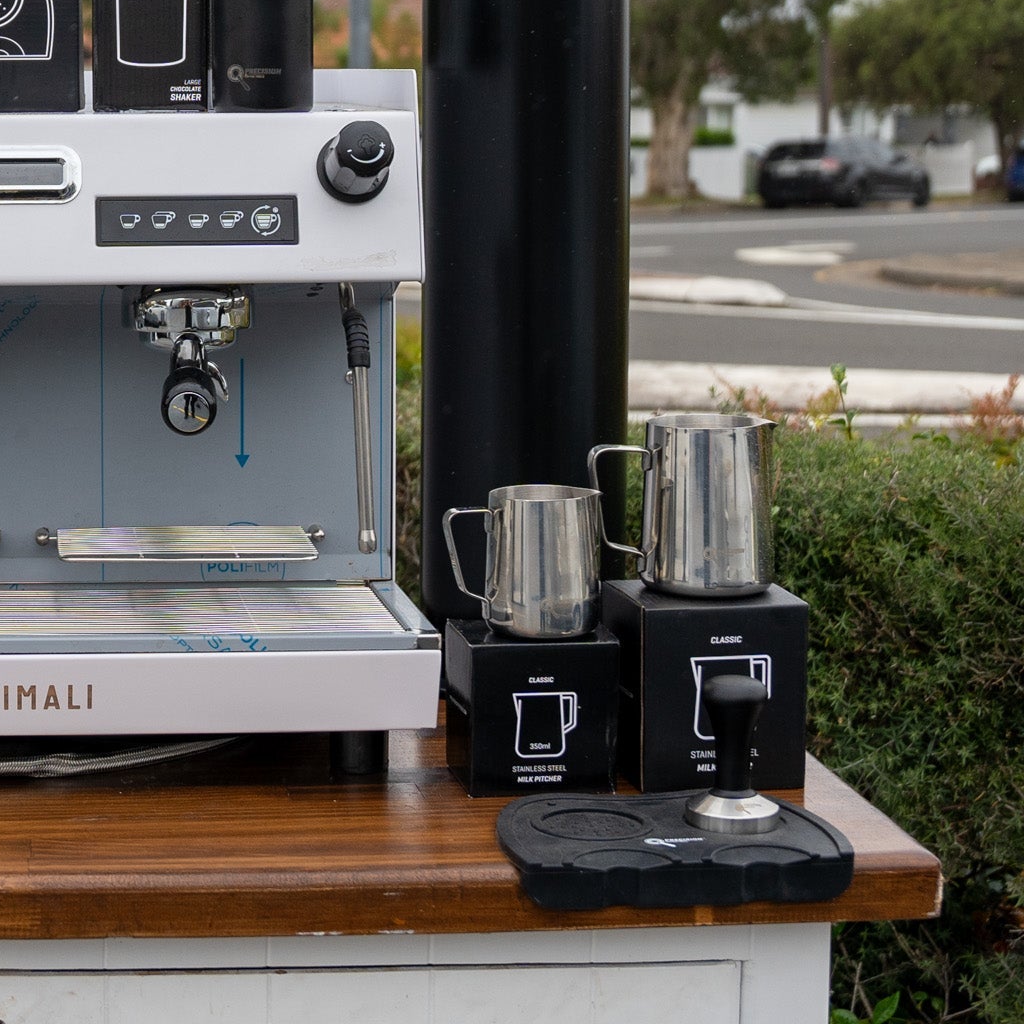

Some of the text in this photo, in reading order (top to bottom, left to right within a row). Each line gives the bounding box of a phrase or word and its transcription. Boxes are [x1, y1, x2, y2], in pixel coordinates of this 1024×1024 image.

[169, 93, 202, 101] SHAKER
[207, 562, 279, 573] POLIFILM
[710, 635, 742, 644] CLASSIC
[528, 676, 555, 684] CLASSIC
[529, 742, 551, 750] 350ml
[690, 750, 716, 759] STAINL
[511, 764, 567, 773] STAINLESS STEEL
[517, 774, 562, 783] MILK PITCHER
